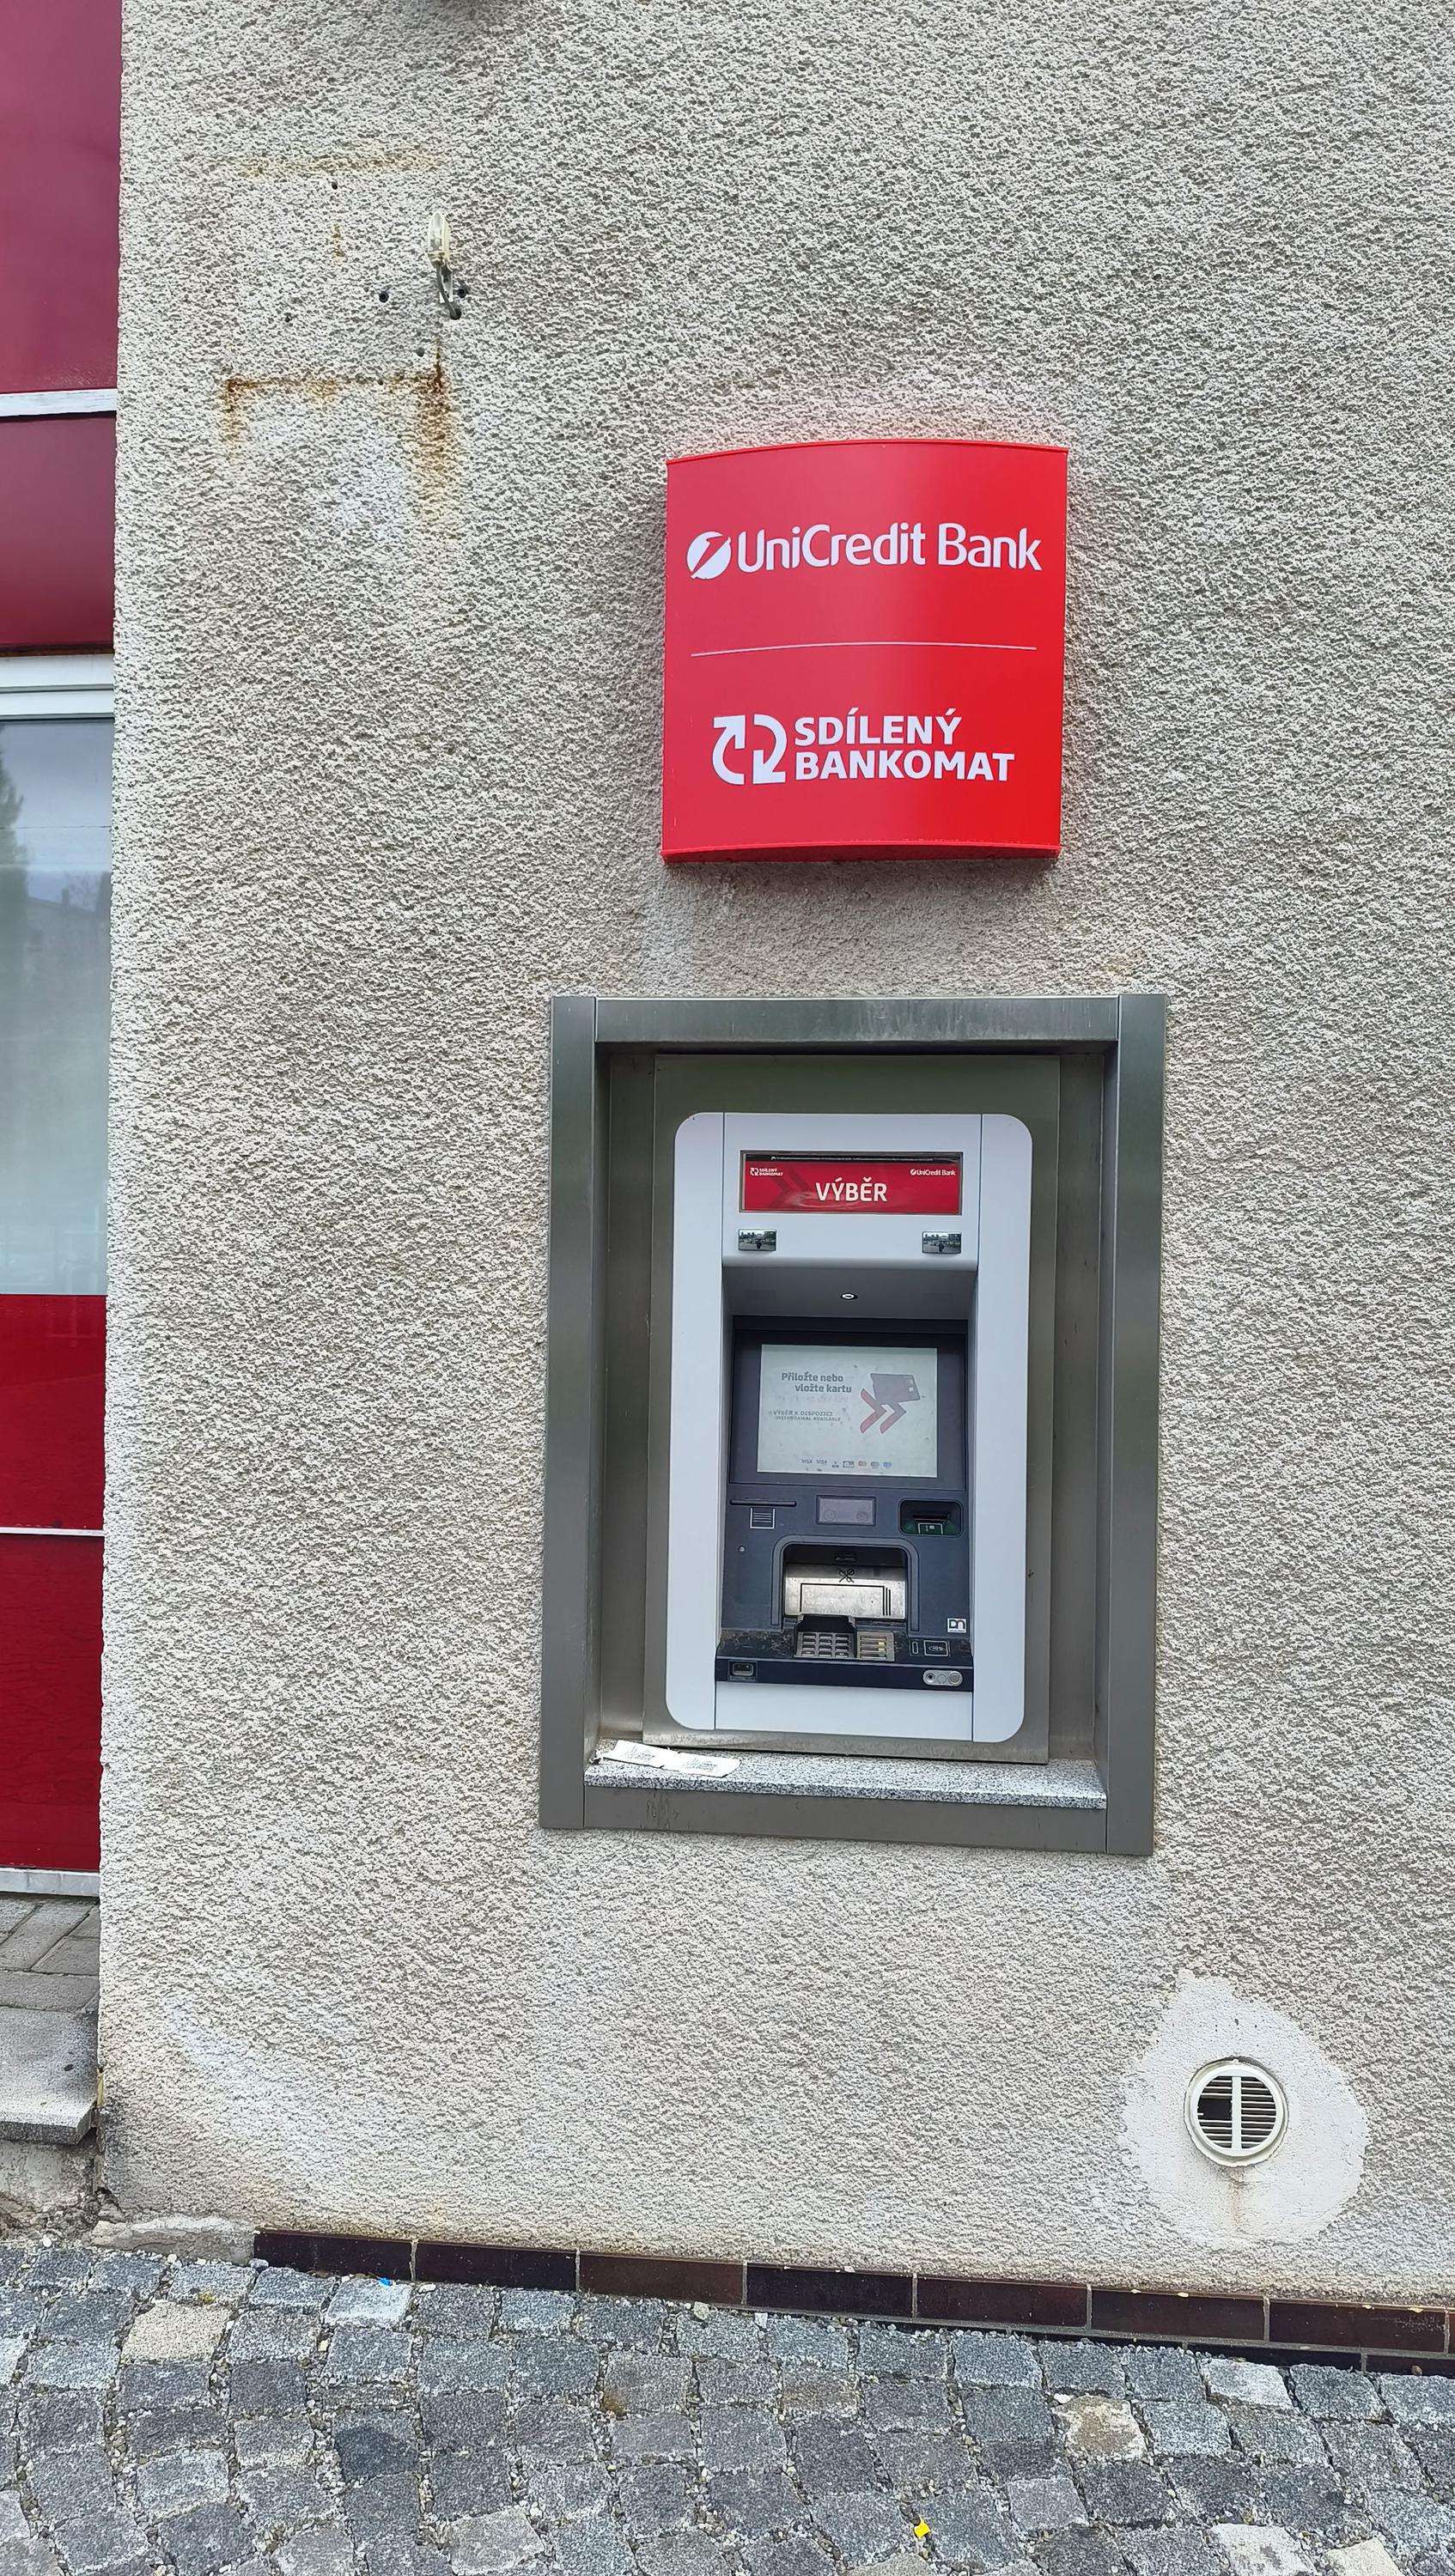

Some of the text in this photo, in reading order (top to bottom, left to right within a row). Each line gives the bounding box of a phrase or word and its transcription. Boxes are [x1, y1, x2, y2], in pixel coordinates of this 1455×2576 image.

[738, 522, 1042, 573] UniCredit Bank
[794, 707, 962, 746] SDÍLENÝ
[795, 750, 1015, 781] BANKOMAT
[815, 1176, 887, 1202] VÝBĚR
[794, 1383, 852, 1393] vložte kartu
[820, 1373, 843, 1382] nebo
